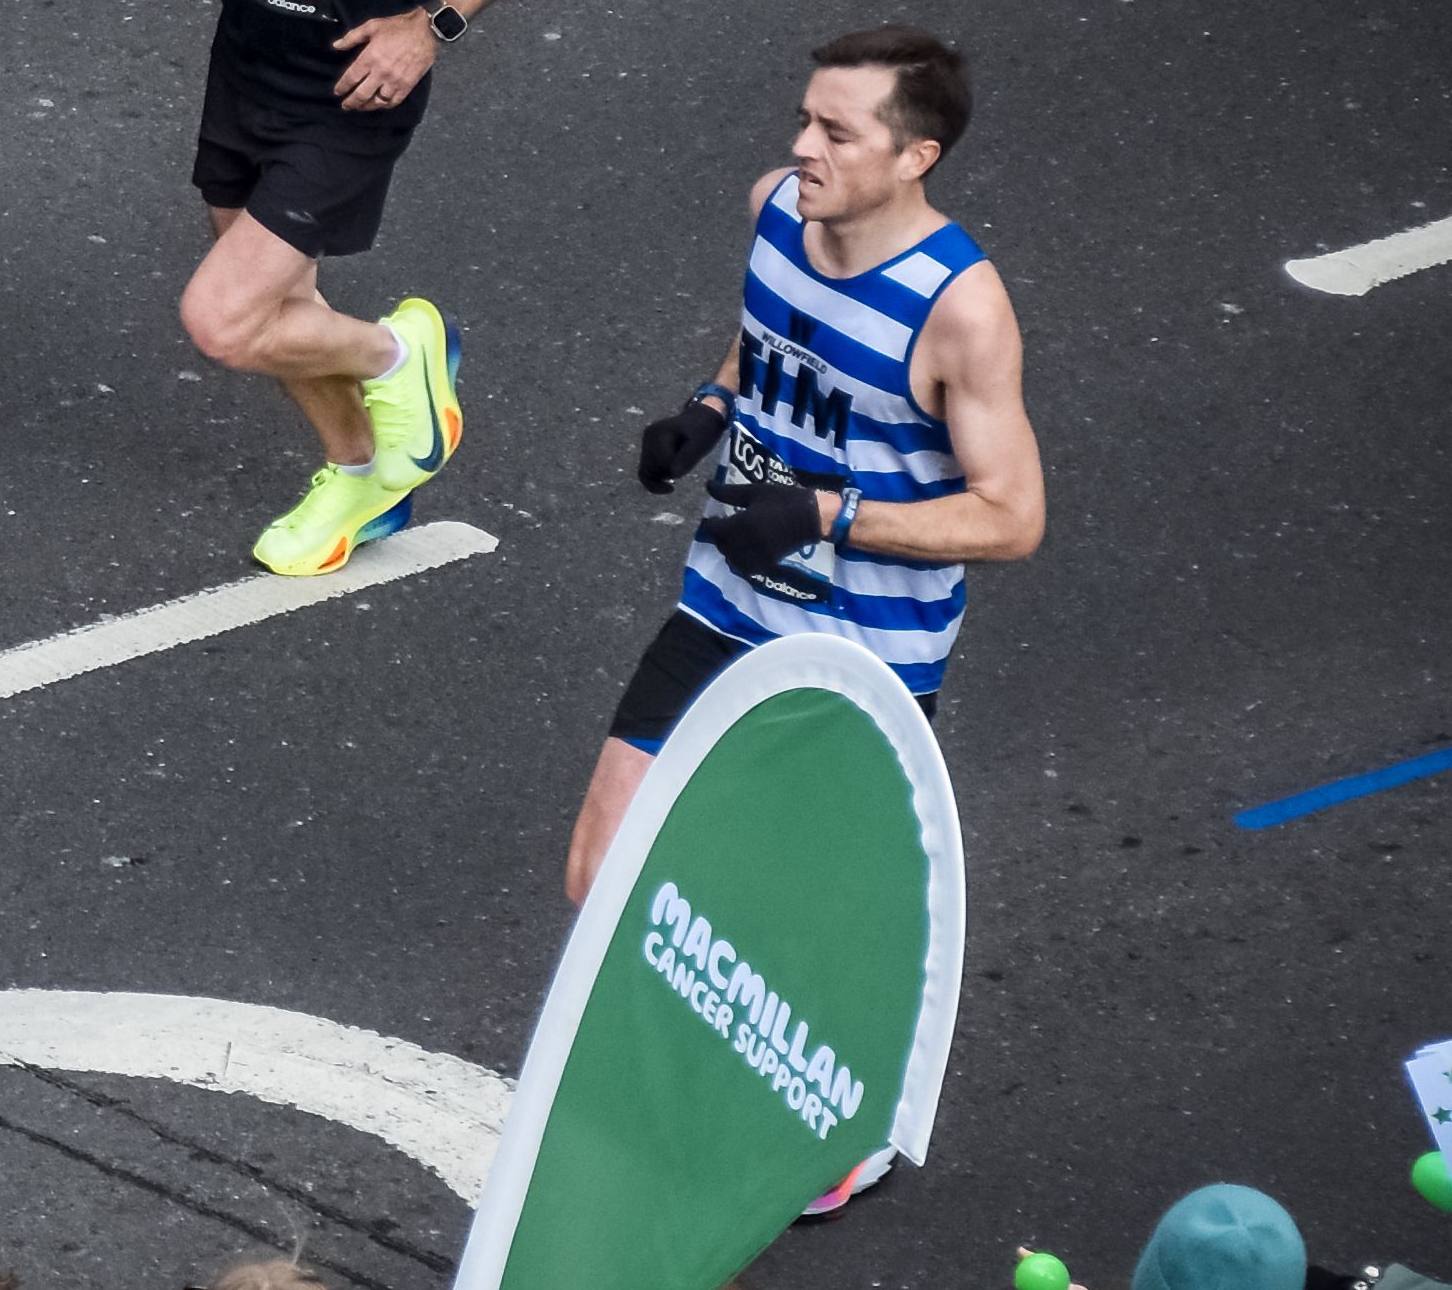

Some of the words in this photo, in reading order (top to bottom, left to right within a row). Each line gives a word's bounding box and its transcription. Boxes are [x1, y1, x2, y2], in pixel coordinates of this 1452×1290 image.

[739, 327, 854, 450] TIM
[761, 330, 829, 375] WILLOWFIELD
[765, 576, 817, 600] balance
[644, 931, 734, 1039] CANCER
[734, 1023, 838, 1140] SUPPORT
[651, 881, 865, 1120] MACMILLAN
